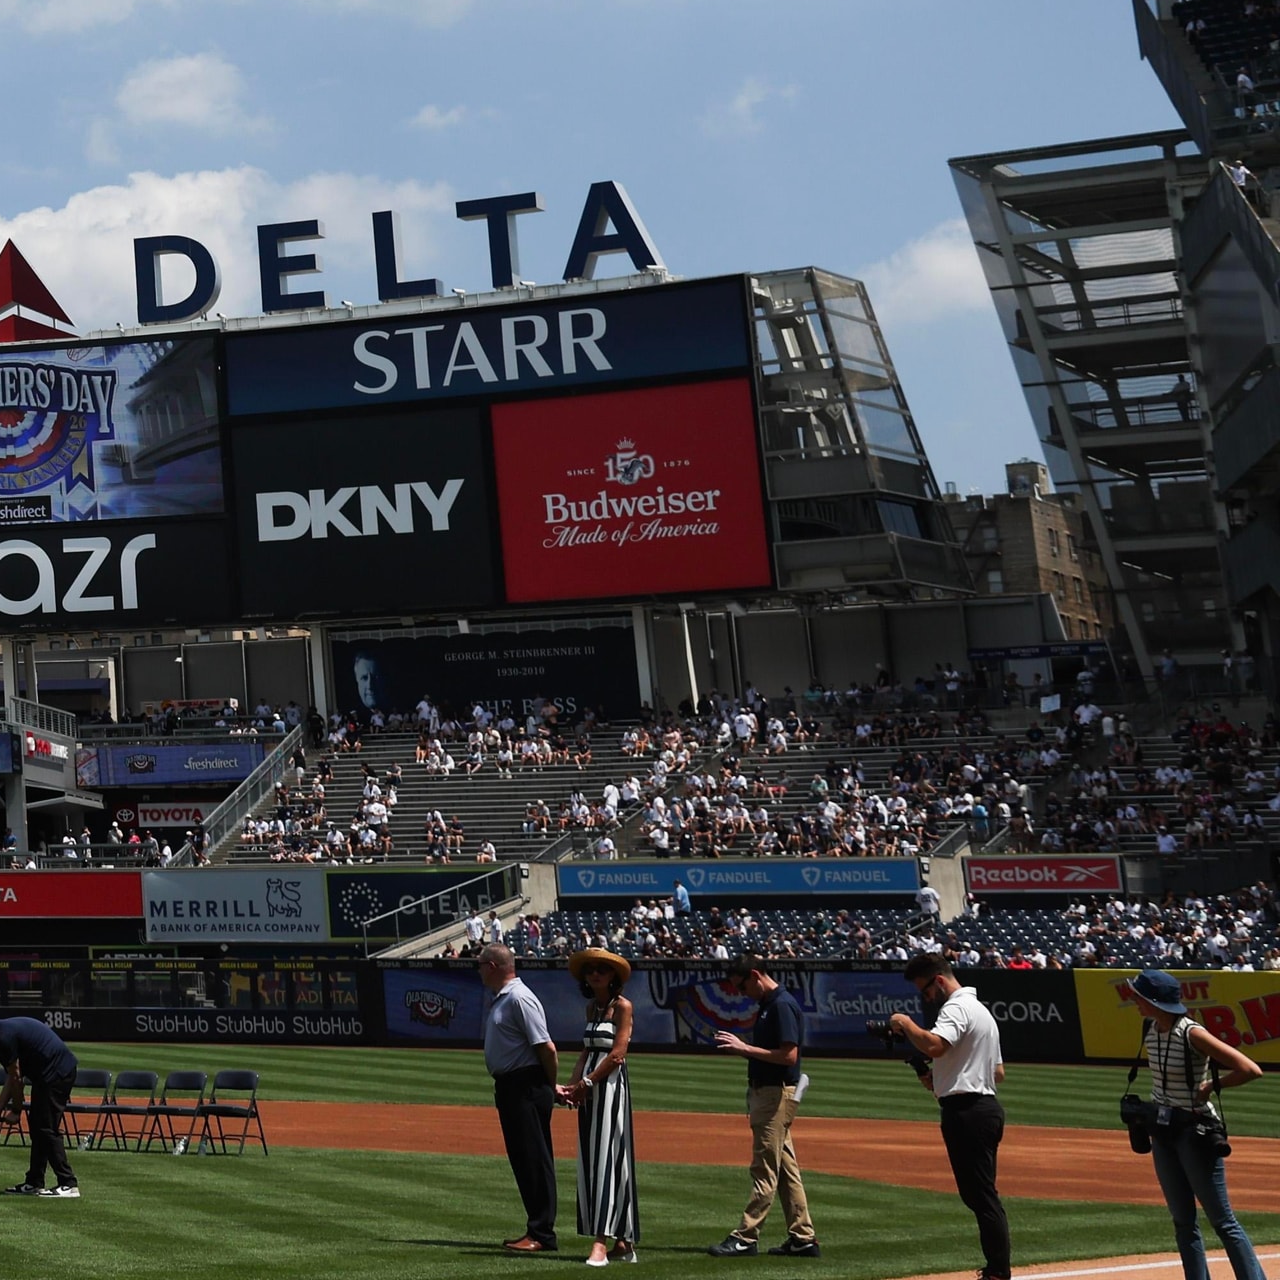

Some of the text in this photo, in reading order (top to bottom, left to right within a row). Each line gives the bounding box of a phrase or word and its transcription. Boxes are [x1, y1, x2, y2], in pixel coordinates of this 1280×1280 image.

[134, 180, 667, 323] DELTA
[353, 308, 613, 394] STARR
[60, 372, 113, 433] DAY
[21, 436, 81, 485] YANKEES
[567, 468, 595, 476] SINCE
[664, 460, 690, 468] 1876
[255, 478, 465, 542] DKNY
[542, 486, 720, 524] Budweiser
[543, 518, 719, 548] Made of America
[444, 646, 595, 662] GEORGE M. STEINBRENNER III
[496, 666, 545, 677] 1930-2010
[185, 757, 239, 770] freshdirect
[140, 809, 203, 822] TOYOTA
[599, 873, 658, 885] FANDUEL
[708, 872, 771, 884] FANDUEL
[825, 870, 890, 882] FANDUEL
[970, 867, 1057, 883] Reebok
[150, 900, 260, 918] MERRILL
[151, 923, 320, 935] A BANK OF AMERICA COMPANY
[827, 993, 921, 1016] freshdirect
[45, 1012, 72, 1028] 385
[135, 1015, 363, 1036] StubHub StubHub StubHub
